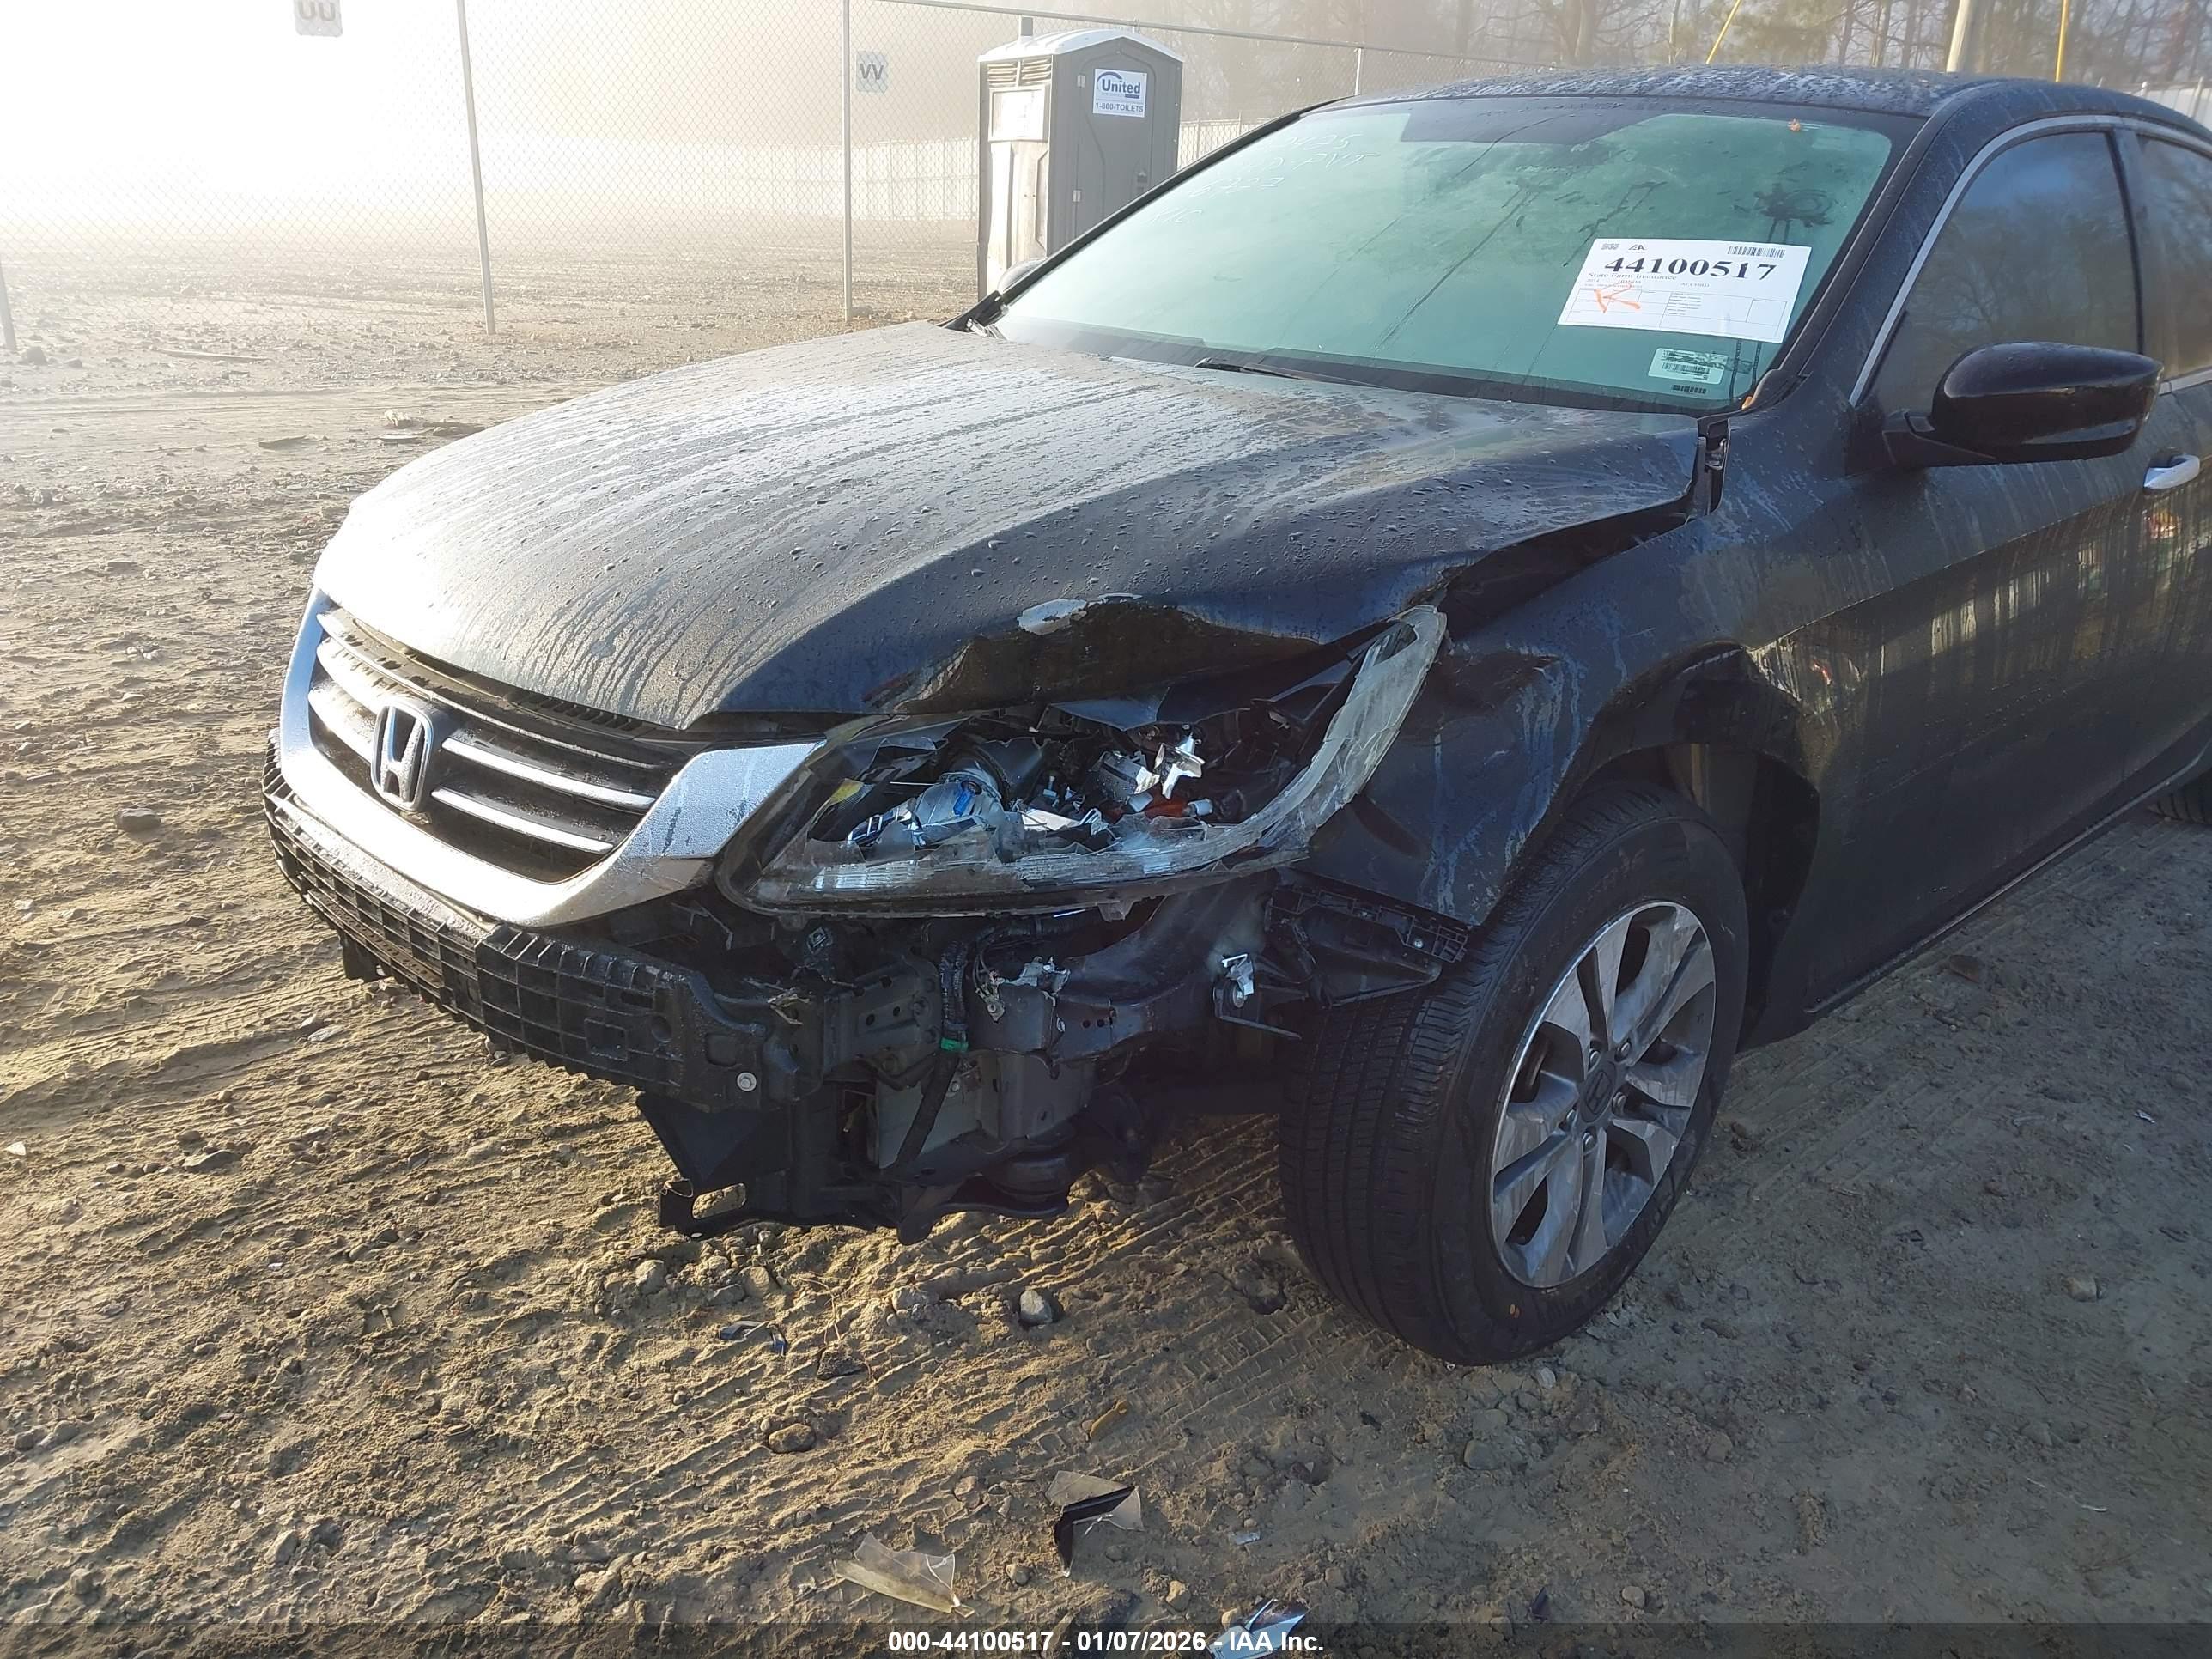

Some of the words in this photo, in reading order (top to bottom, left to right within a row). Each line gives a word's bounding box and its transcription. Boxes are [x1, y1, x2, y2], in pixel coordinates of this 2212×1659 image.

[1102, 79, 1140, 94] United
[1096, 102, 1144, 113] 1-800-TOILETS
[1604, 256, 1778, 281] 44100517
